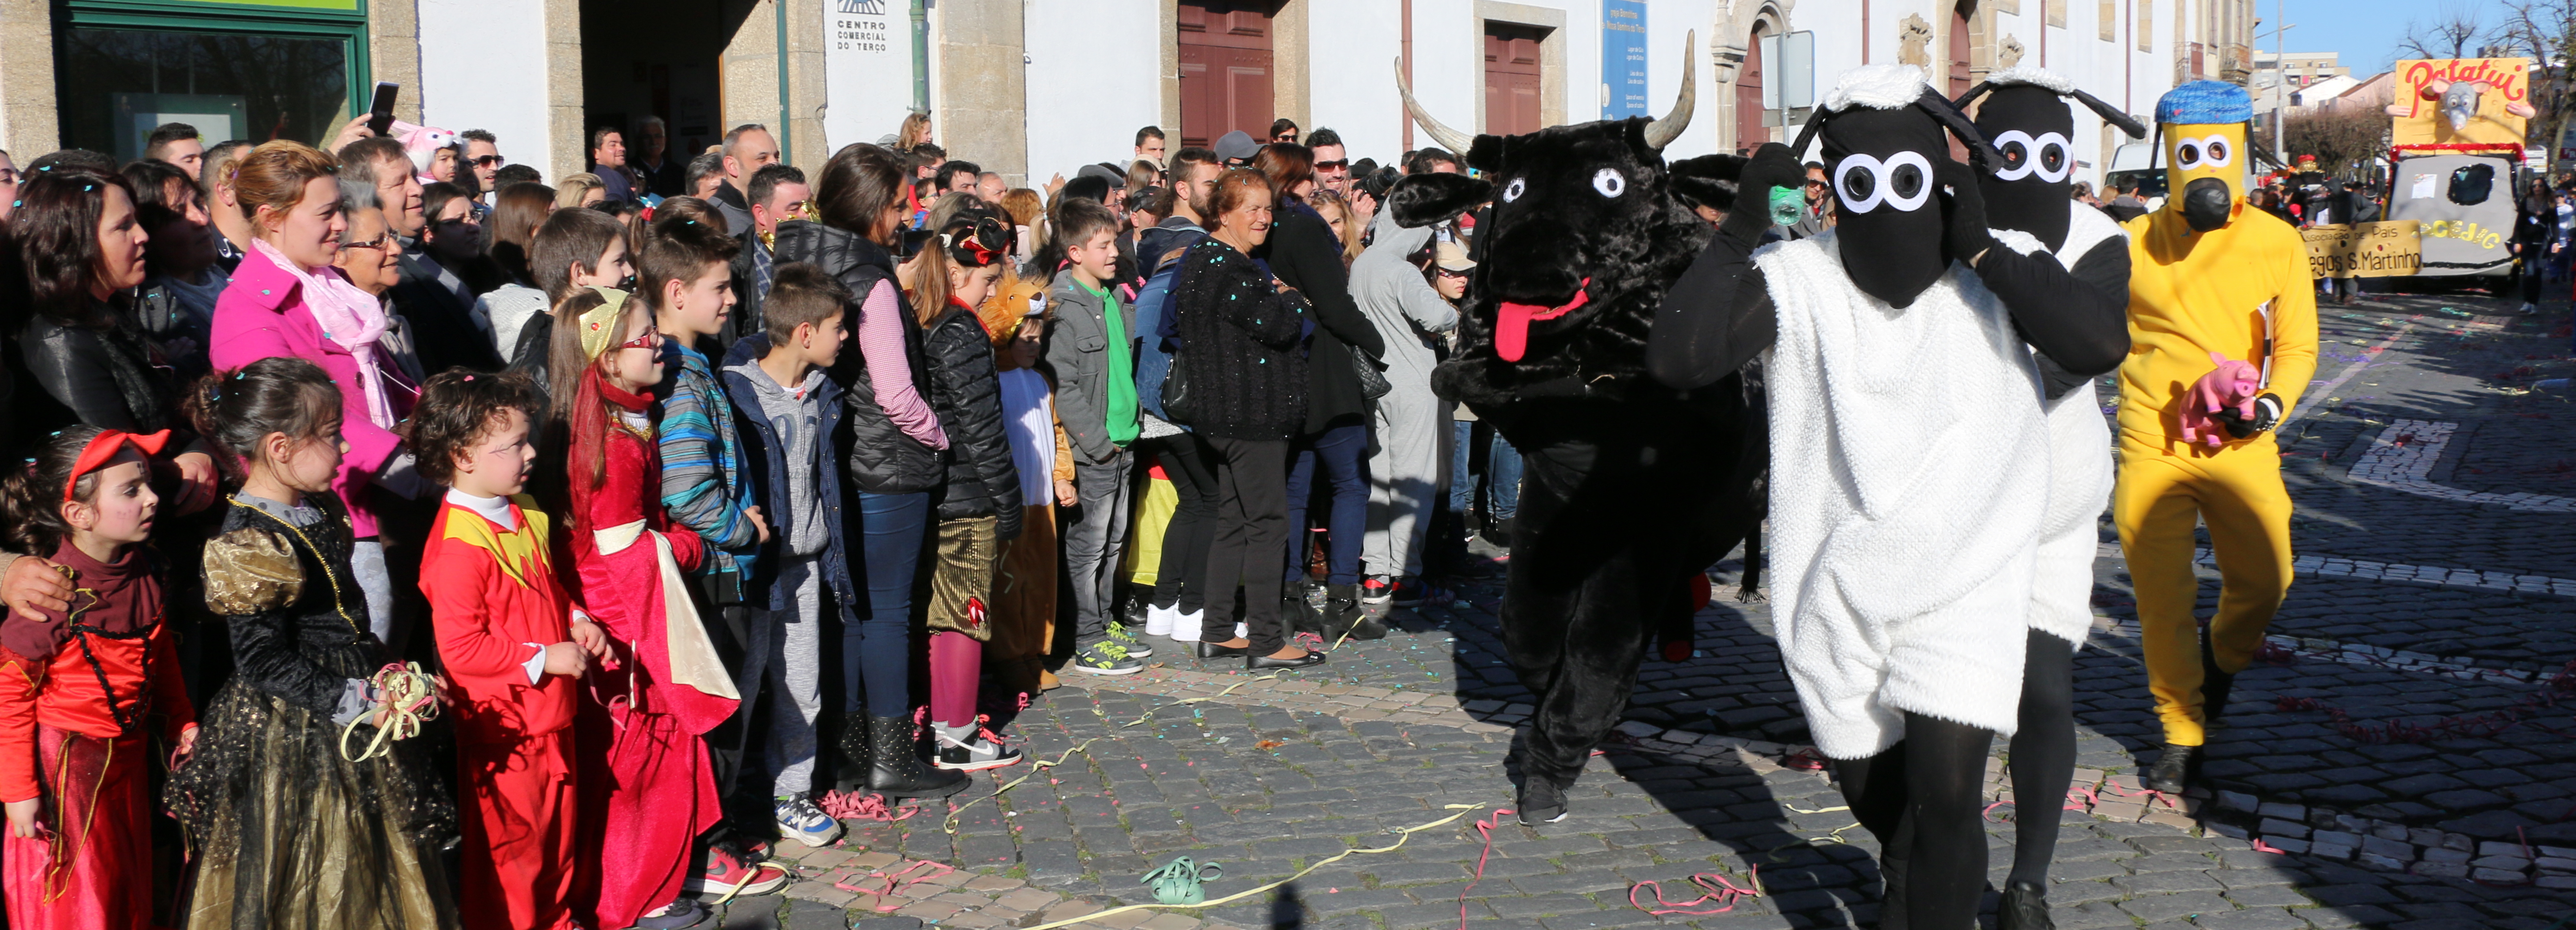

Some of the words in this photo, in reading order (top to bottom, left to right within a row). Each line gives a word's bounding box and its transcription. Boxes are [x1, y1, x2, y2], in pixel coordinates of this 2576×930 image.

[837, 20, 886, 30] CENTRO
[837, 31, 886, 41] COMERCIAL
[837, 41, 849, 50] DO
[857, 42, 886, 54] TERÇO
[2372, 226, 2399, 239] Pais
